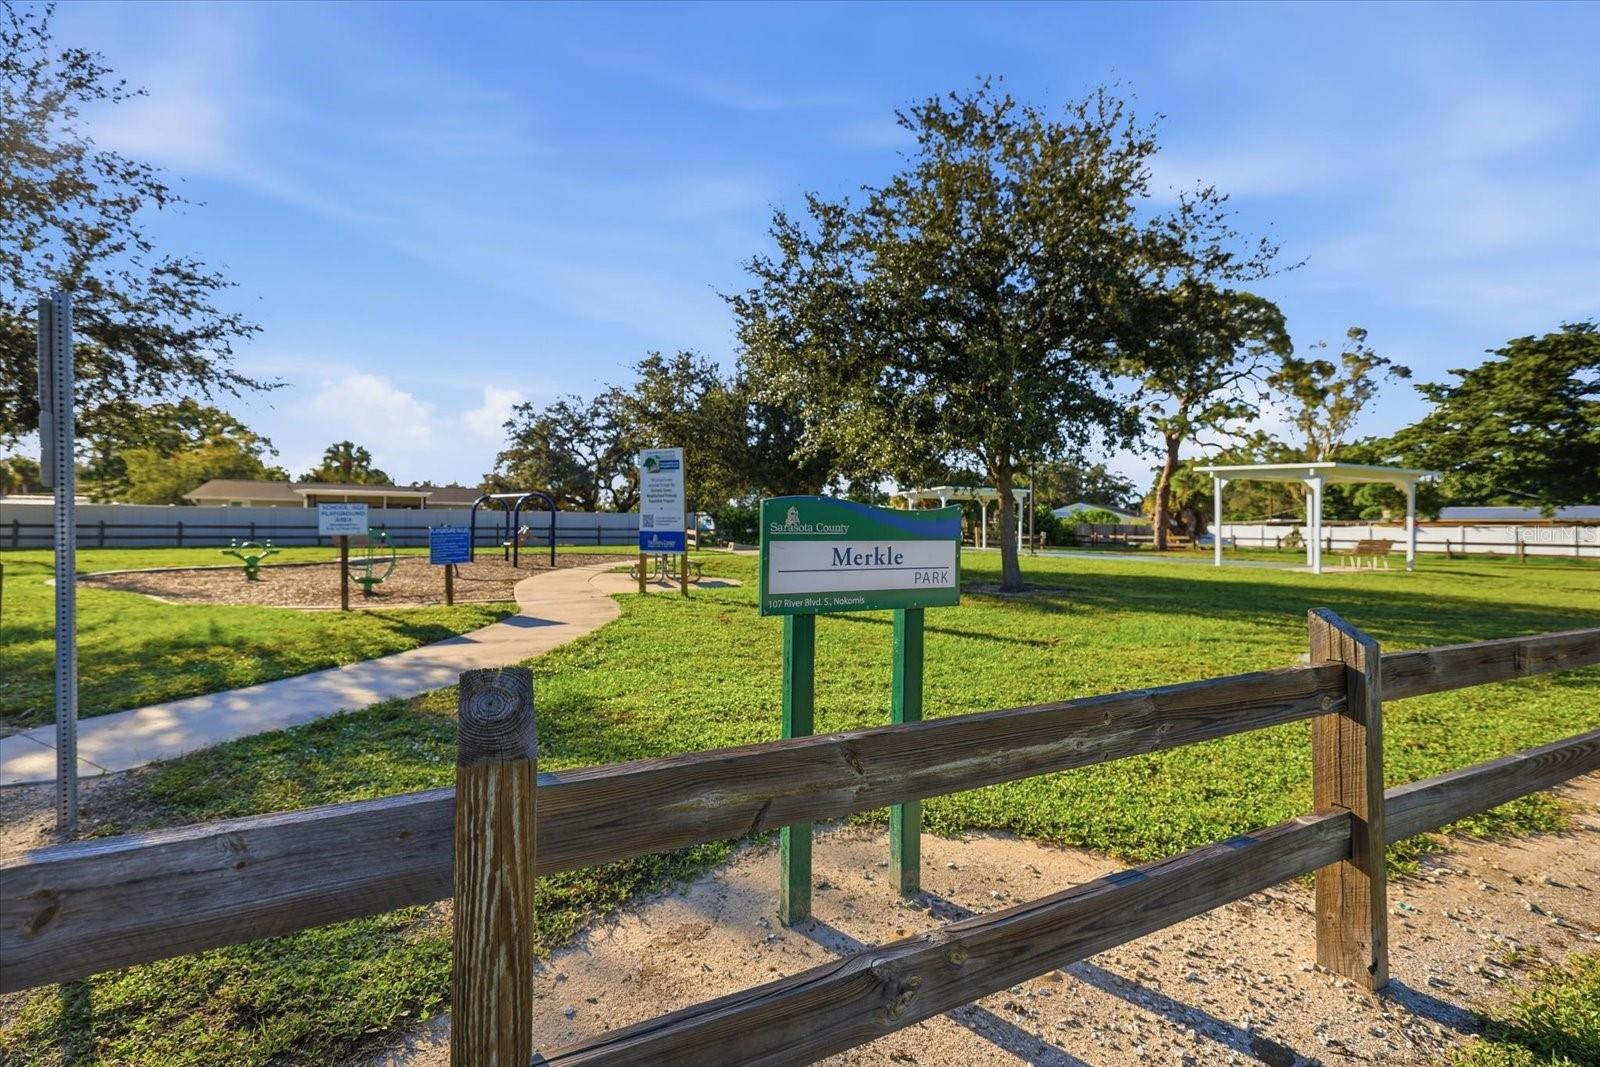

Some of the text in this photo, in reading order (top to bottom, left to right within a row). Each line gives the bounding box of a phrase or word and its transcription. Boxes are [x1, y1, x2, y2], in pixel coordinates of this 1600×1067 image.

[770, 522, 850, 535] Sarasota County
[832, 546, 904, 567] Merkle
[914, 571, 949, 585] PARK
[768, 599, 783, 609] 107
[784, 598, 803, 608] River
[804, 596, 823, 607] Blvd.
[834, 596, 865, 606] Nokomis
